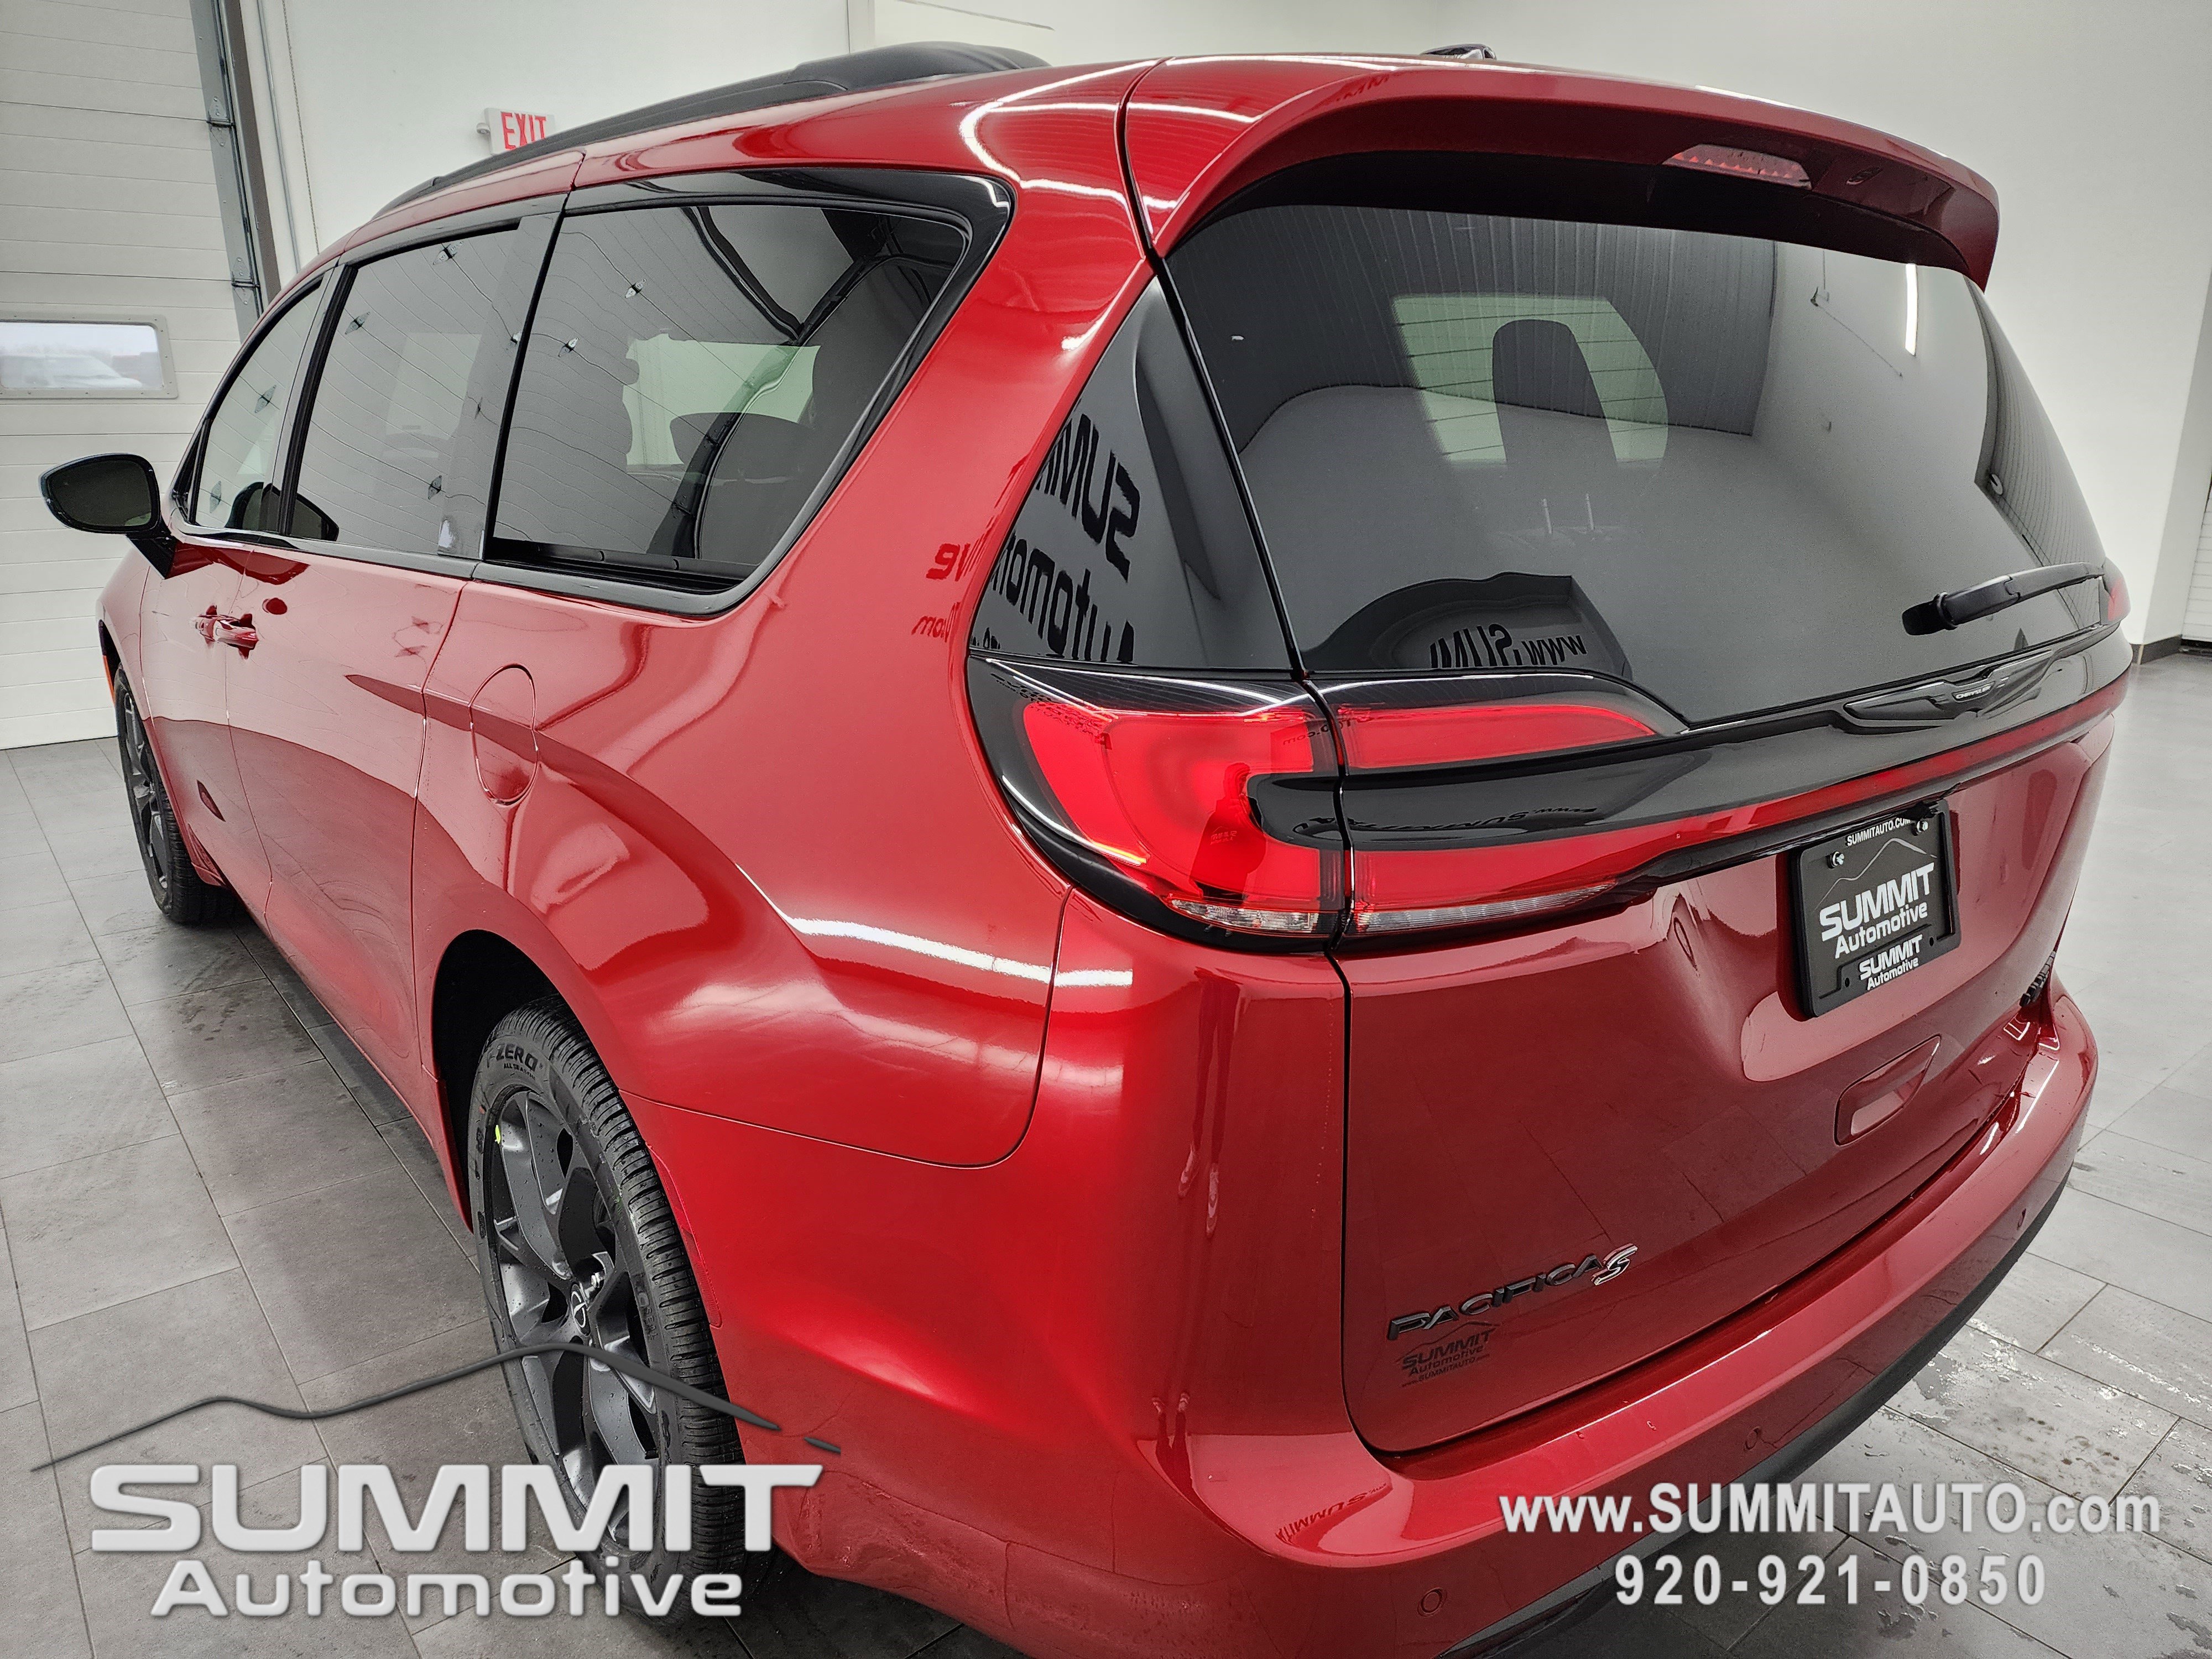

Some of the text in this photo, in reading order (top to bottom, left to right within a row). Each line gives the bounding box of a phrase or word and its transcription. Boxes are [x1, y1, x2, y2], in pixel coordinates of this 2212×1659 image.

[500, 111, 547, 151] EXIT
[1955, 685, 1991, 699] CHRYSLER
[1819, 862, 1935, 942] SUMMIT
[1835, 902, 1928, 959] Automotive
[1859, 934, 1923, 980] SUMMIT
[1866, 957, 1919, 990] Automotive
[496, 1044, 538, 1072] ZERO
[1387, 1254, 1603, 1340] PACIFICA
[1402, 1327, 1497, 1371] SUMMIT
[1408, 1345, 1484, 1377] Automotive
